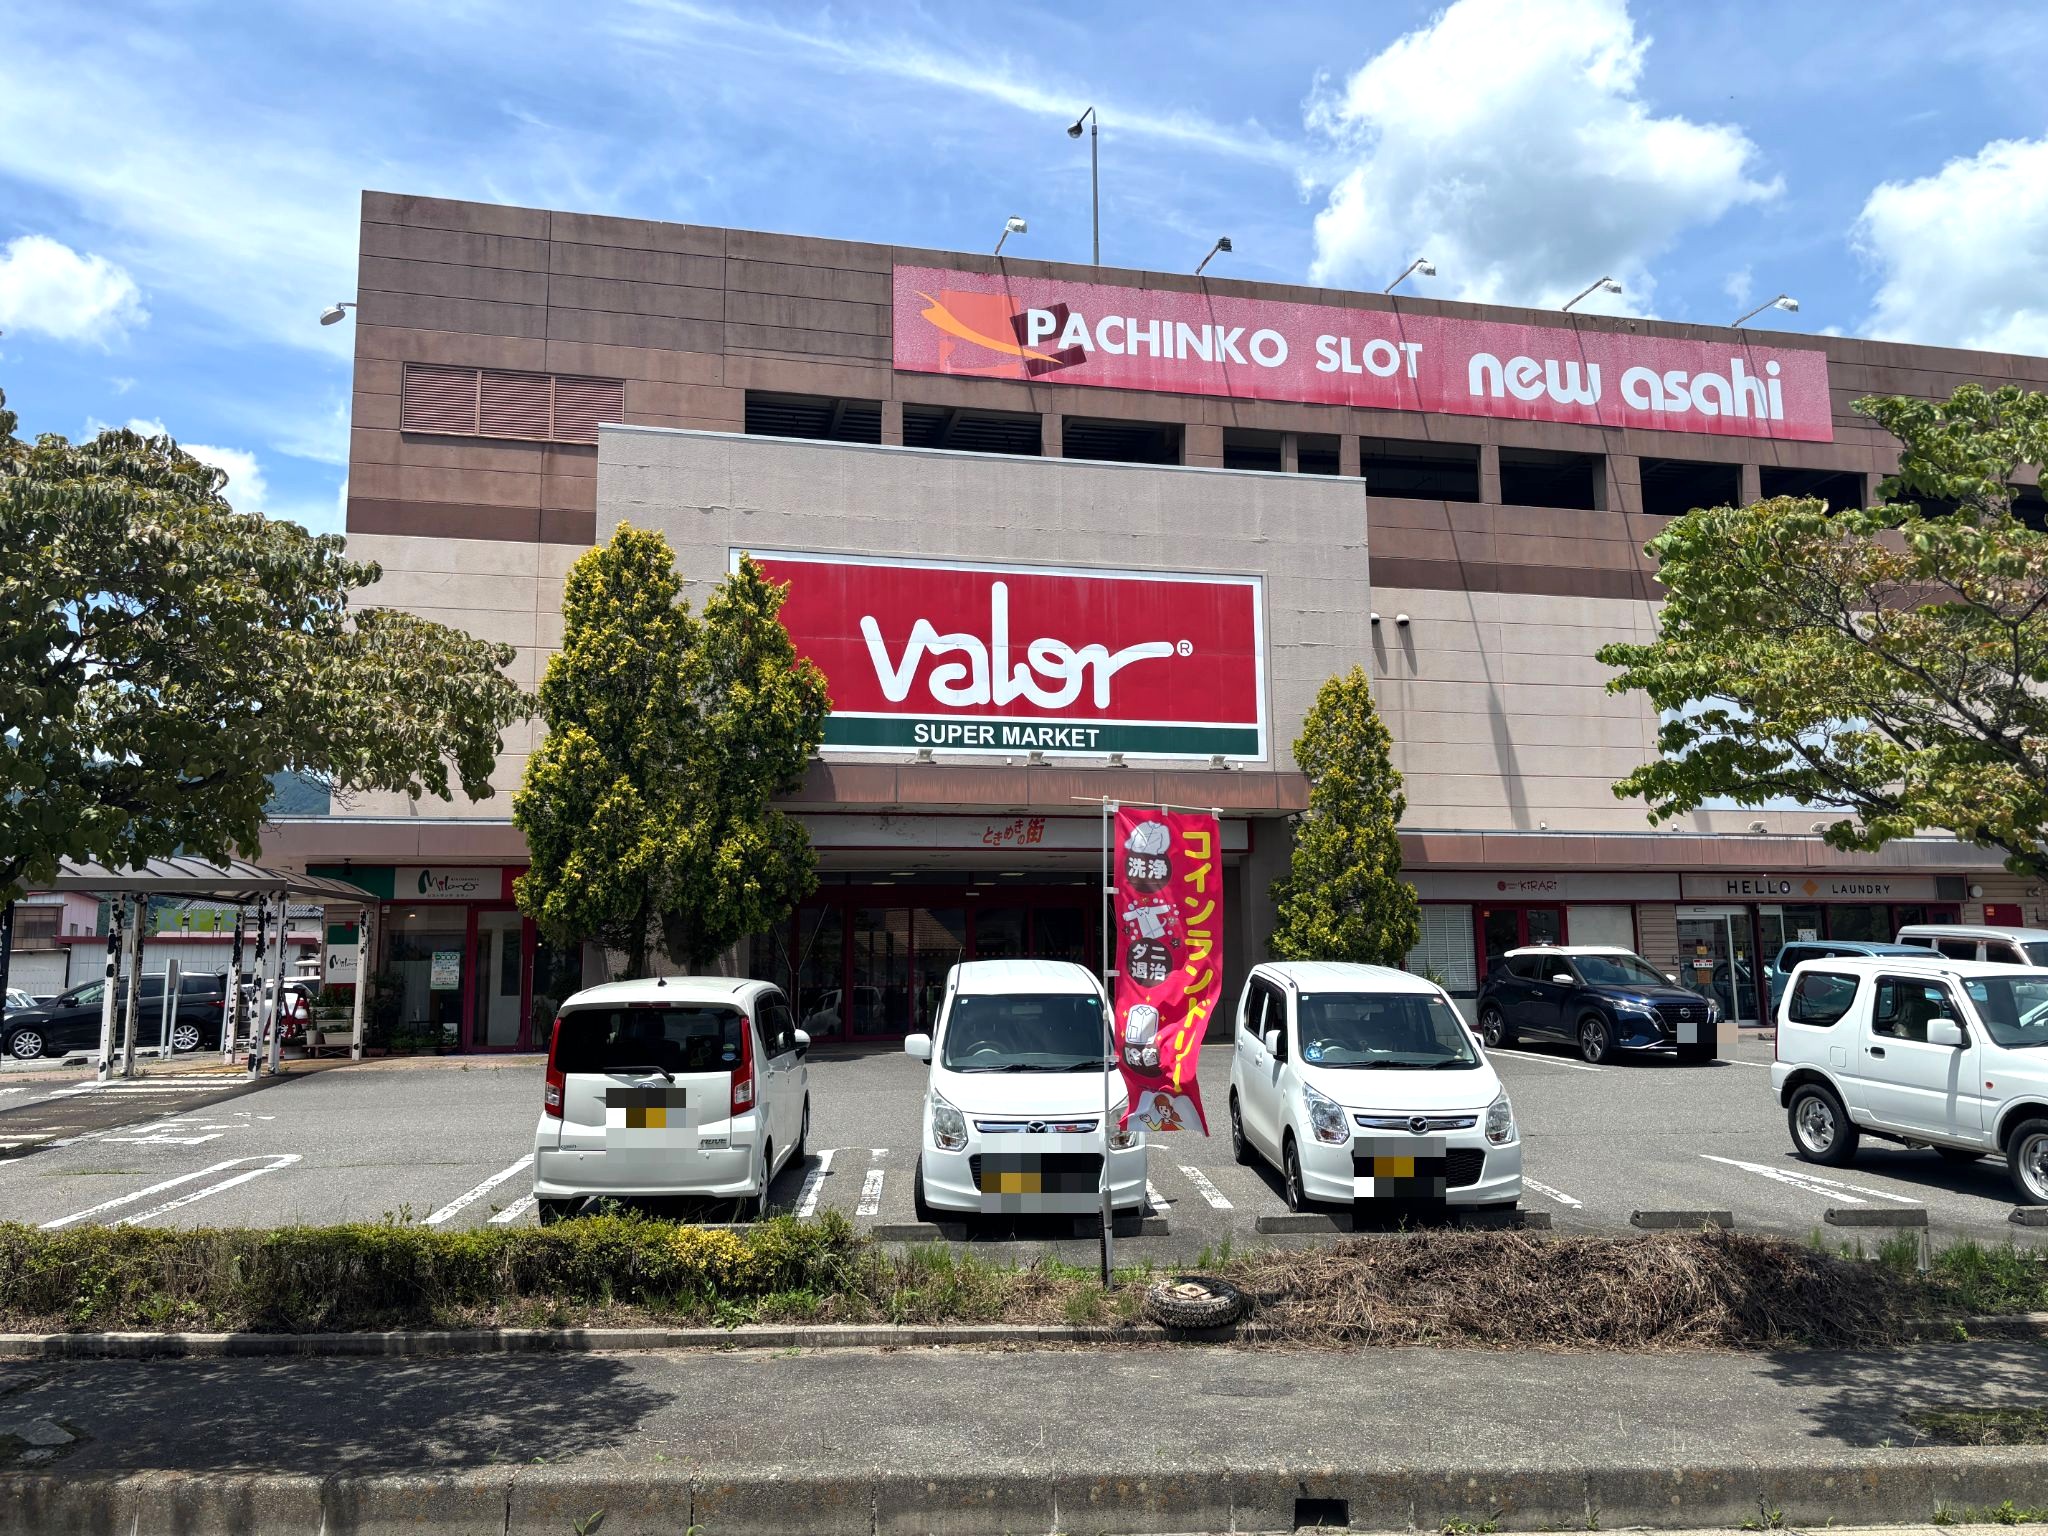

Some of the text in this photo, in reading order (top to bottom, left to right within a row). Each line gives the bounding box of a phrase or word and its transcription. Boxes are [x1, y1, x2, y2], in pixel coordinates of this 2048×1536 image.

[1027, 308, 1423, 378] PACHINKO SLOT
[1468, 352, 1783, 420] new asahi
[914, 723, 1100, 748] SUPER MARKET
[982, 818, 1046, 846] ときめきの街
[1128, 857, 1168, 879] 洗浄
[1727, 880, 1891, 895] HELLO LAUNDRY
[1132, 943, 1167, 960] ダニ
[1172, 831, 1215, 1093] コインランドリー
[1131, 961, 1167, 981] 退治
